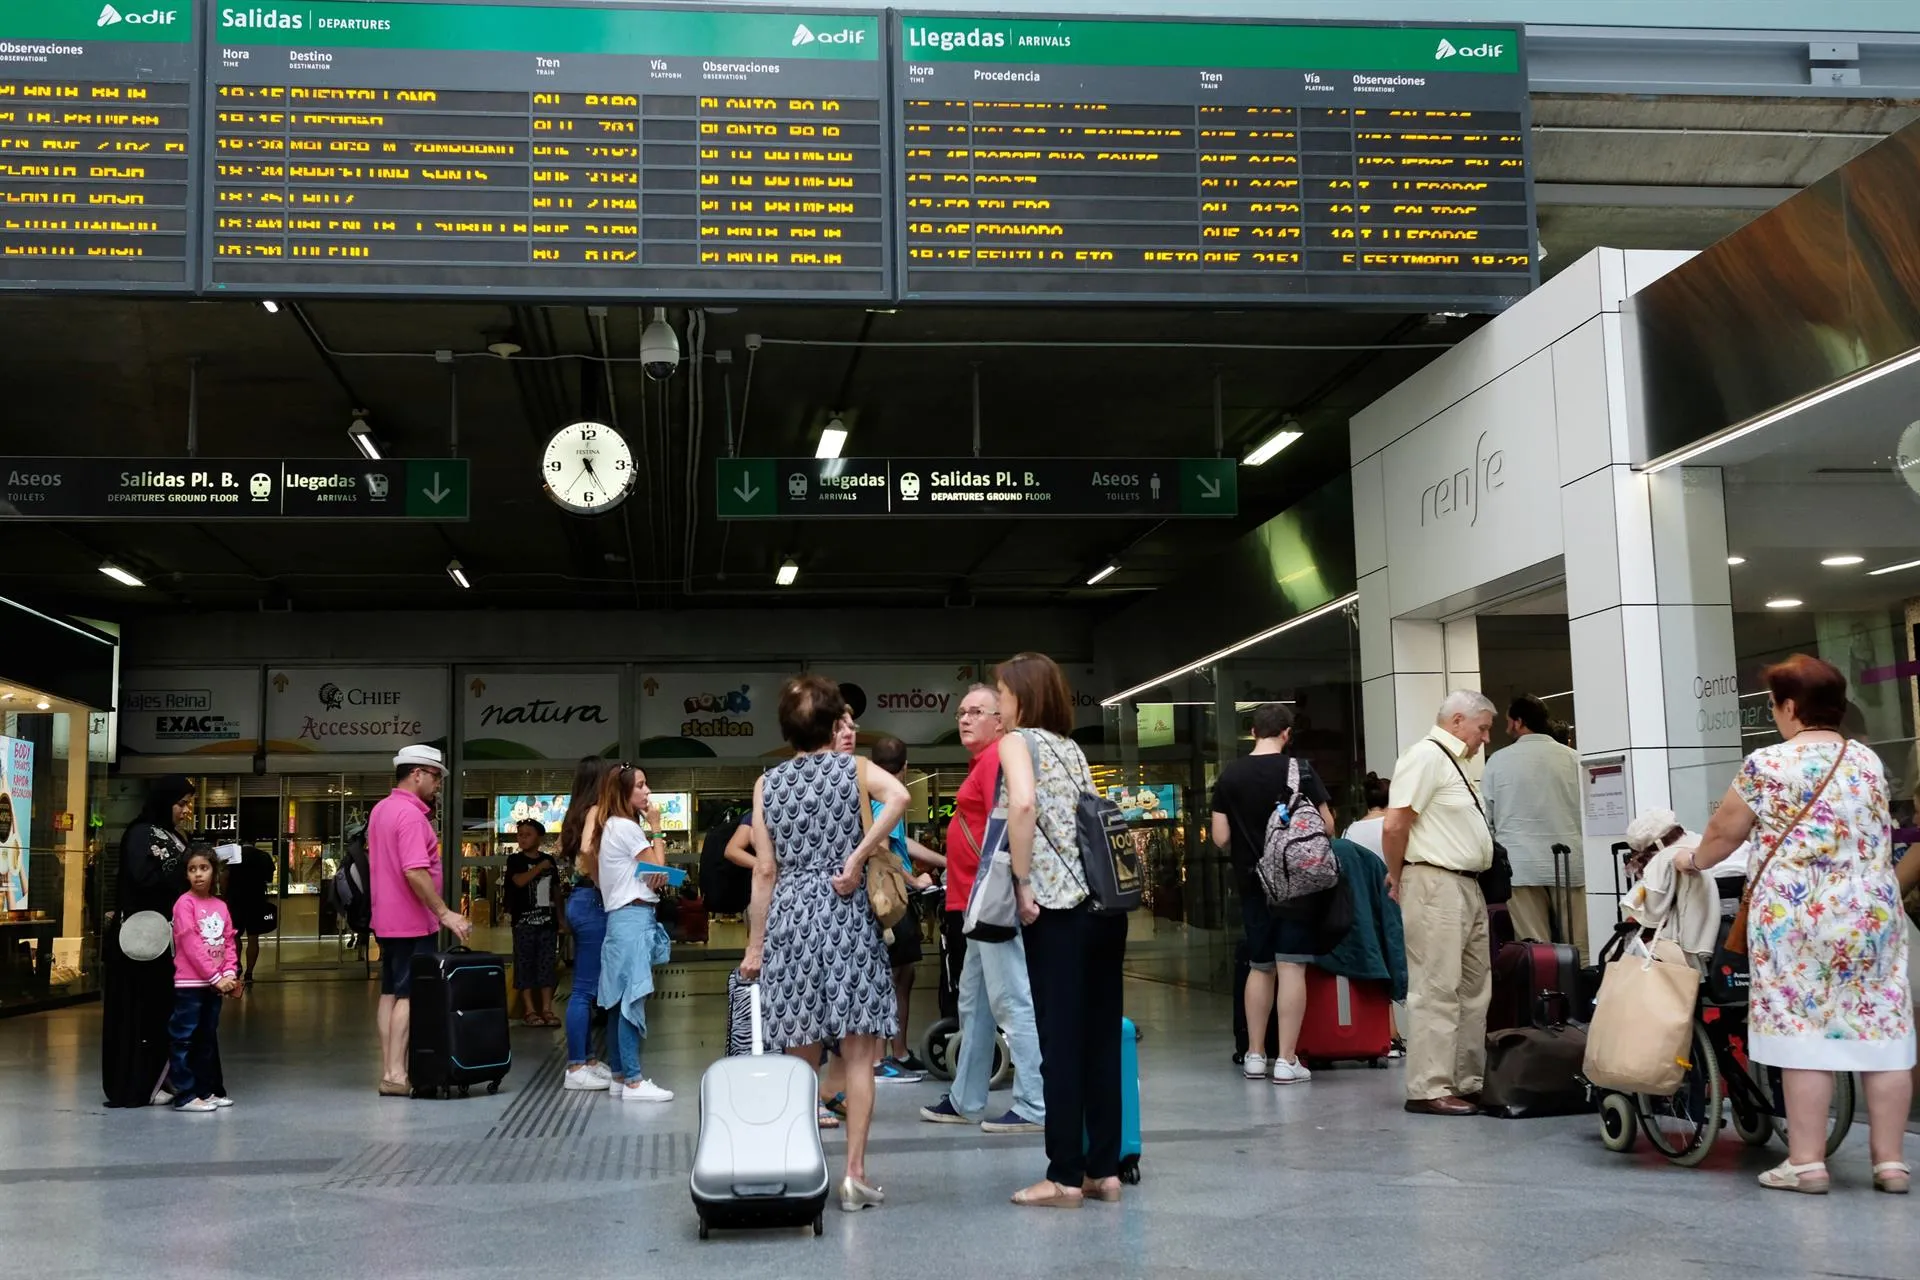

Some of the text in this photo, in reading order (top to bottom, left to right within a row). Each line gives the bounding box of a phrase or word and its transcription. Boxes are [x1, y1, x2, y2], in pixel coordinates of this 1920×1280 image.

[125, 10, 177, 25] adif
[222, 8, 391, 30] Salidas DEPARTURES
[817, 30, 865, 44] adif
[910, 27, 1071, 51] Llegadas ARRIVALS
[0, 42, 83, 55] Observaciones
[222, 48, 250, 60] Hora
[1459, 44, 1503, 57] adif
[289, 50, 333, 63] Destino
[536, 57, 560, 68] Tren
[650, 59, 667, 71] Vía
[702, 61, 780, 74] Observaciones
[909, 65, 934, 76] Hora
[974, 70, 1040, 82] Procedencia
[1200, 72, 1222, 82] Tren
[1304, 73, 1320, 84] Vía
[1353, 74, 1425, 87] Observaciones
[580, 430, 596, 441] 12
[551, 460, 625, 472] 9 3
[8, 470, 62, 487] Aseos
[120, 471, 239, 488] Salidas Pl. B.
[286, 473, 356, 490] Llegadas
[820, 472, 885, 490] Llegadas
[931, 471, 1040, 488] Salidas Pl. B.
[1092, 473, 1140, 487] Aseos
[1421, 430, 1505, 527] renfe
[8, 492, 45, 502] TOILETS
[108, 494, 239, 503] DEPARTURES GROUND FLOOR
[317, 494, 357, 503] ARRIVALS
[584, 492, 594, 502] 6
[819, 493, 857, 501] ARRIVALS
[931, 492, 1051, 502] DEPARTURES GROUND FLOOR
[1106, 493, 1140, 501] TOILETS
[1694, 676, 1737, 699] Centro
[126, 693, 206, 712] iajes Reina
[877, 688, 950, 713] smöoy
[481, 699, 609, 727] natura
[1696, 705, 1762, 732] Customer
[299, 714, 421, 740] Accessorize
[681, 716, 754, 737] station
